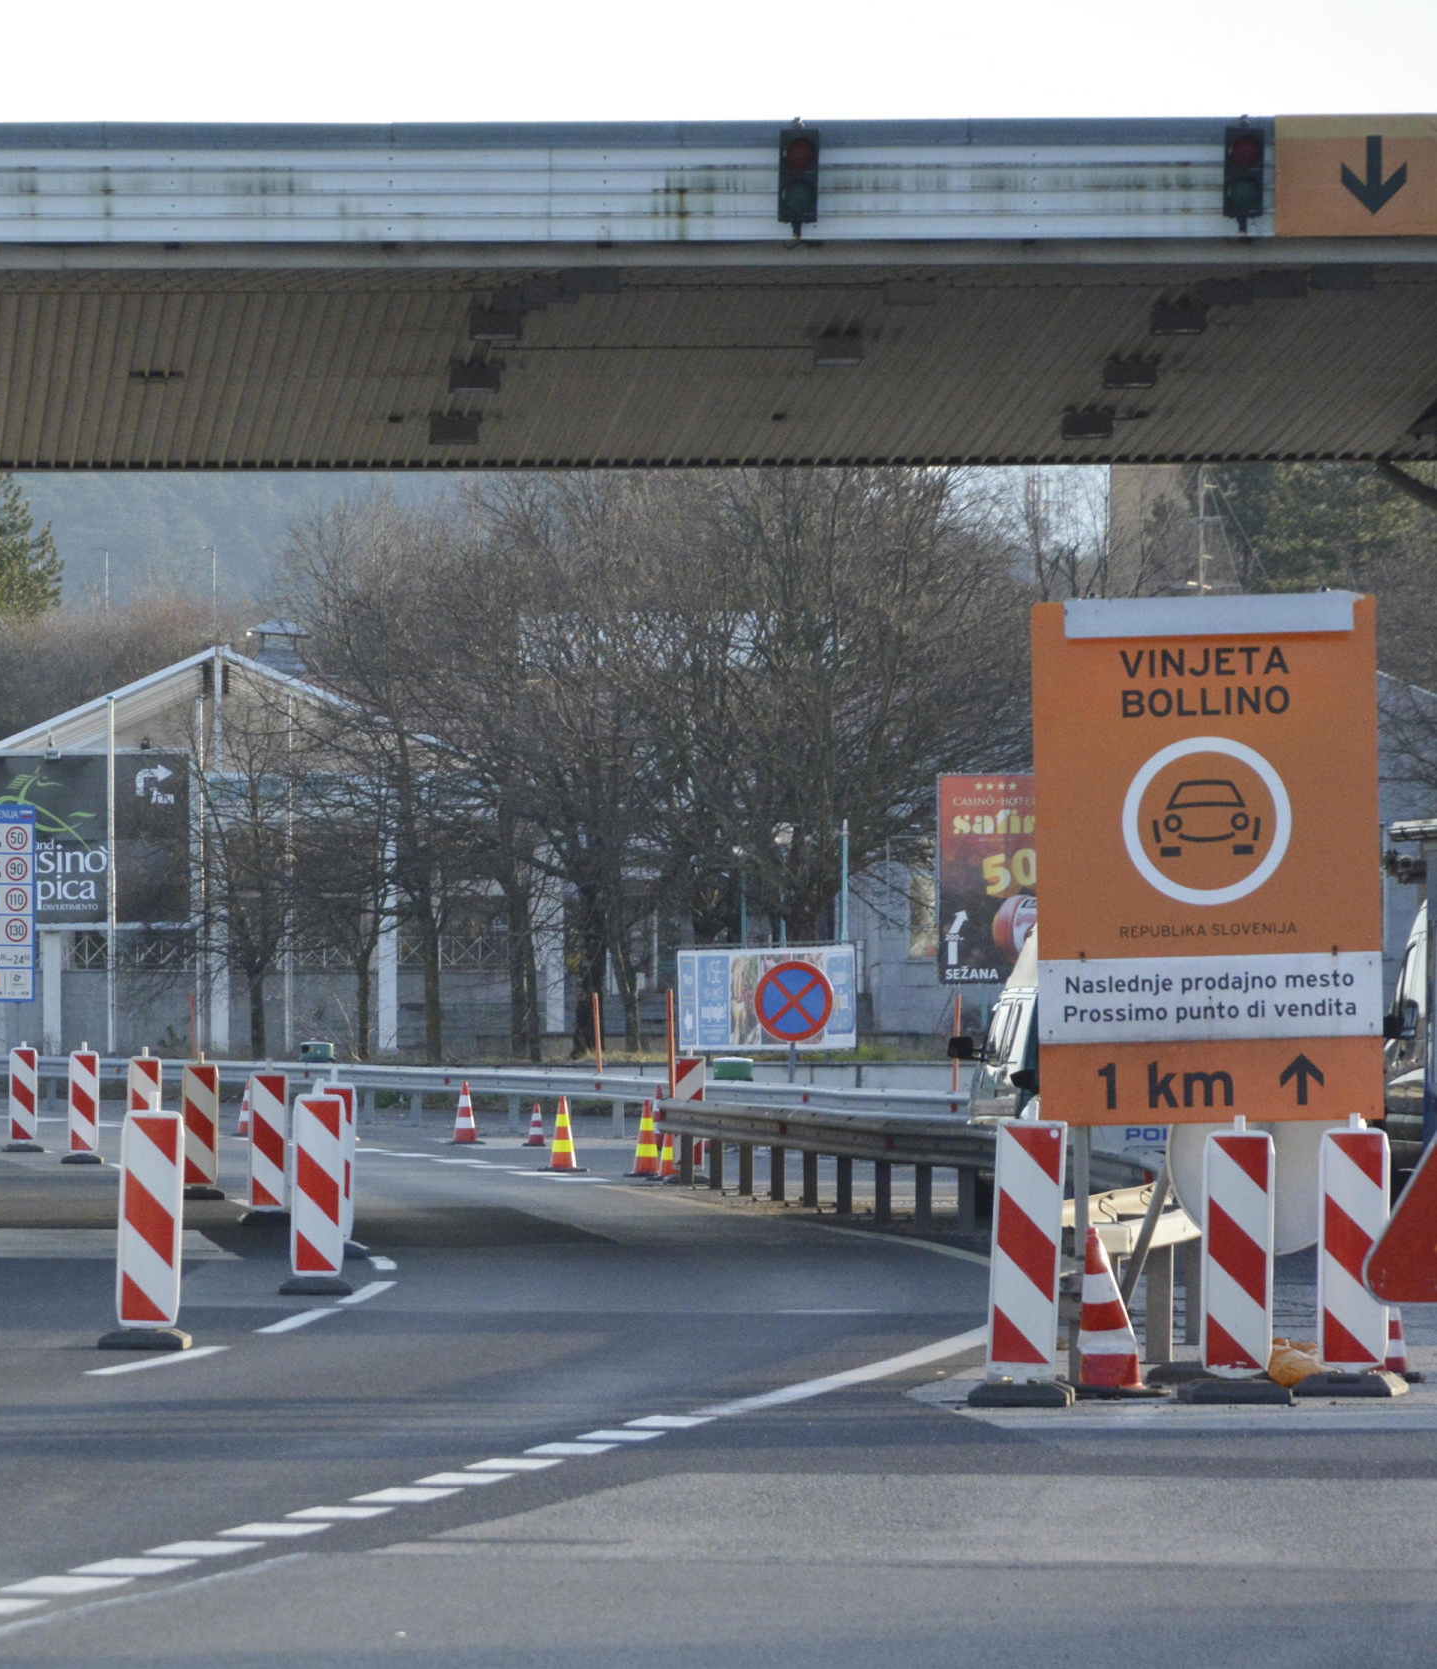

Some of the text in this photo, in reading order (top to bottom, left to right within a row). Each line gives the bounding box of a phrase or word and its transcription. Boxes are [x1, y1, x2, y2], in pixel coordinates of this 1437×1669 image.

[1119, 646, 1290, 678] VINJETA
[1121, 685, 1291, 718] BOLLINO
[10, 832, 24, 845] 50
[9, 862, 23, 875] 90
[9, 894, 24, 905] 110
[36, 875, 96, 910] pica
[9, 925, 24, 936] 130
[1119, 922, 1298, 938] REPUBLIKA SLOVENIJA
[945, 966, 999, 979] SEŽANA
[1064, 970, 1355, 996] Naslednje prodajno mesto
[1063, 997, 1358, 1023] Prossimo punto di vendita
[1097, 1060, 1235, 1109] 1 km
